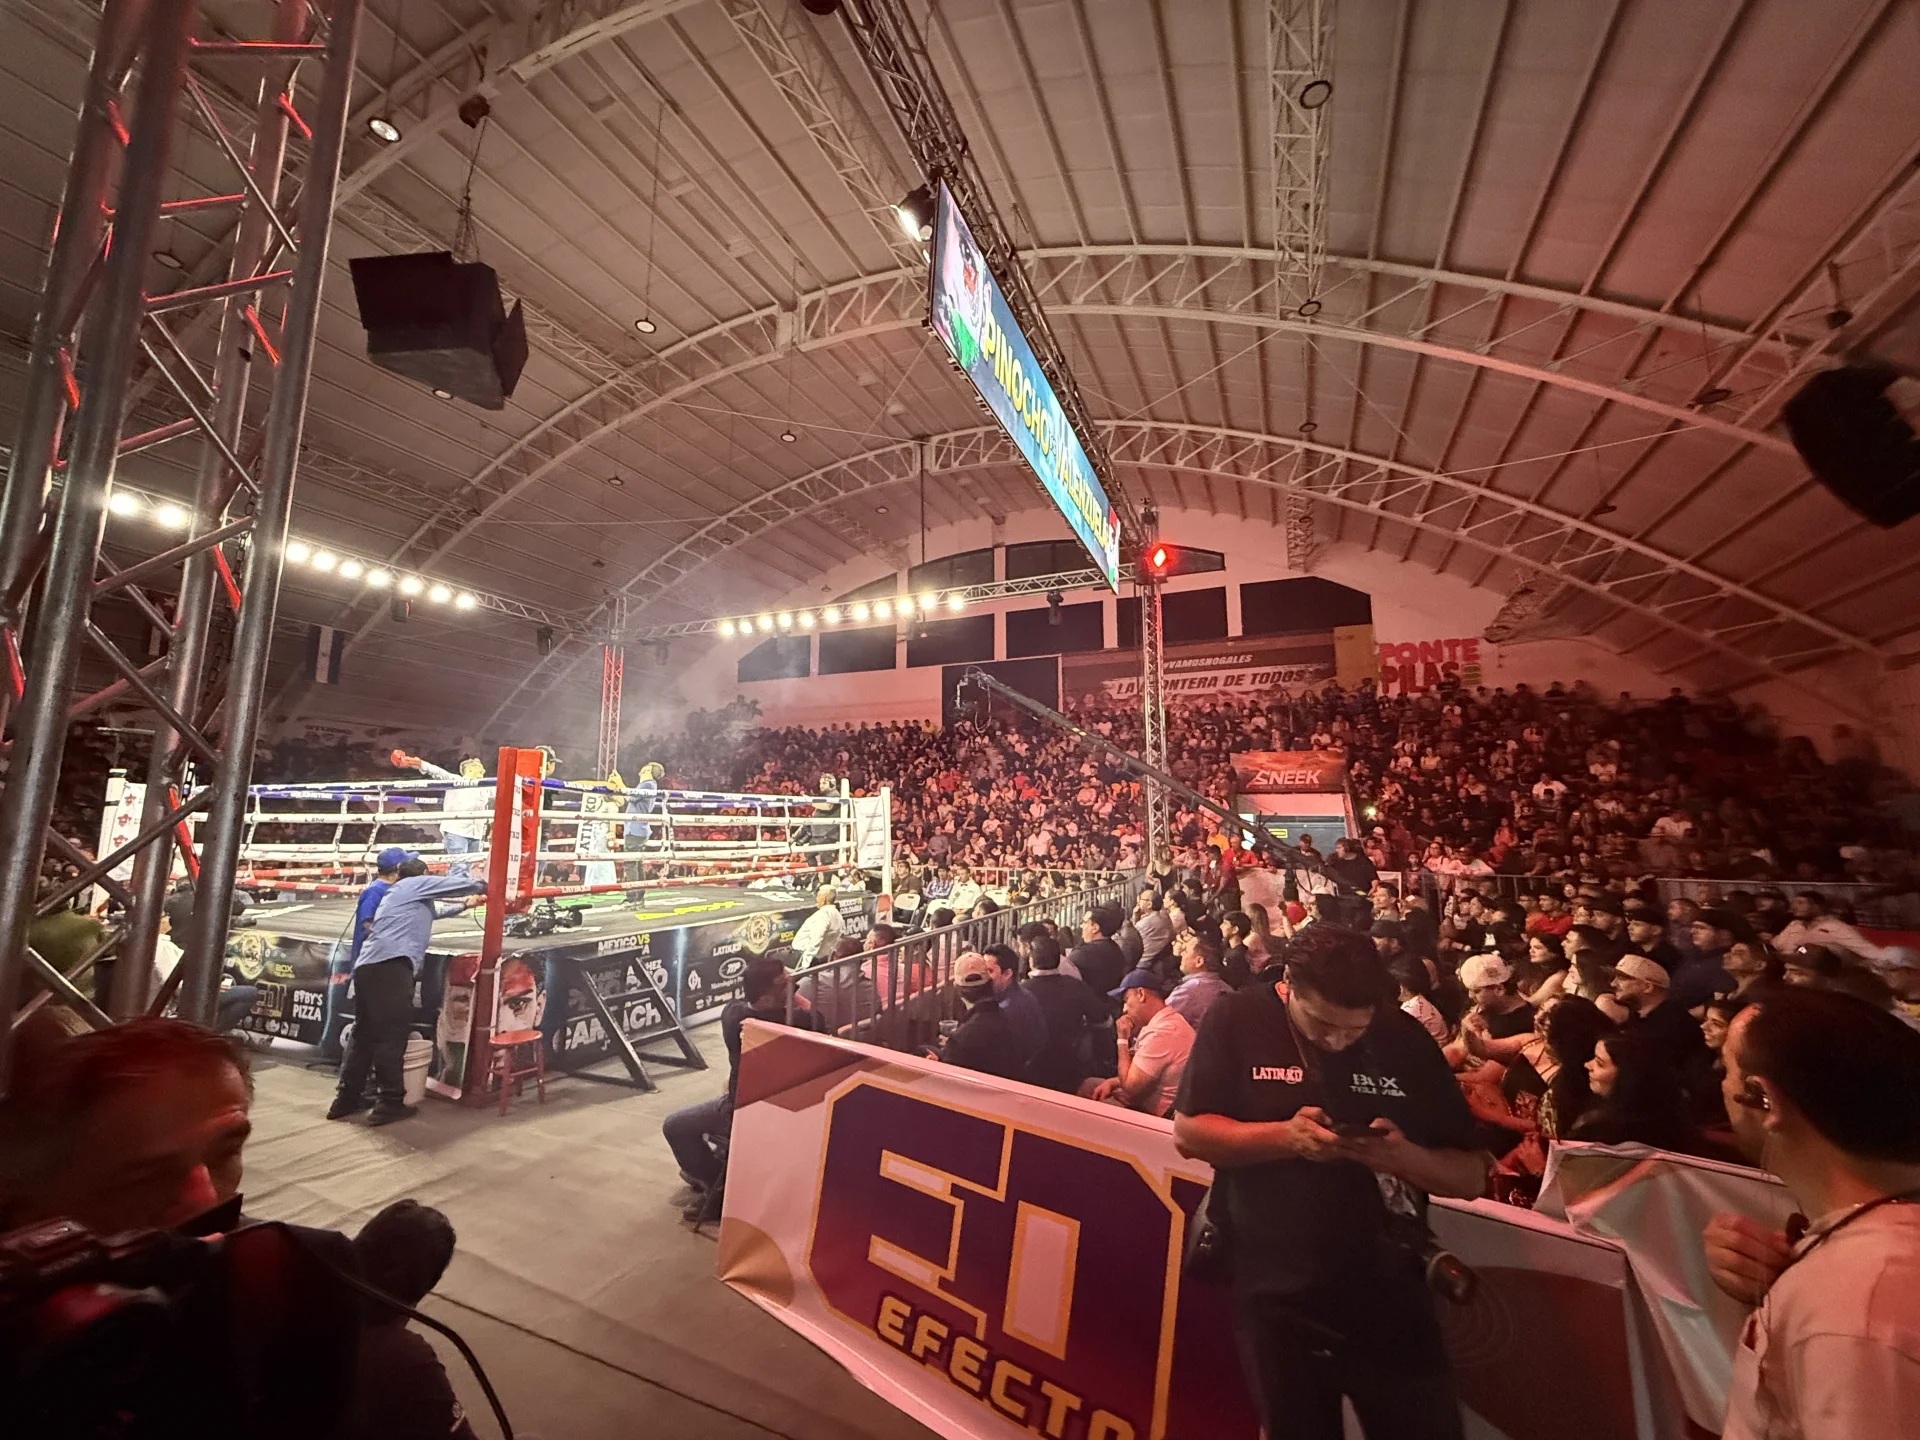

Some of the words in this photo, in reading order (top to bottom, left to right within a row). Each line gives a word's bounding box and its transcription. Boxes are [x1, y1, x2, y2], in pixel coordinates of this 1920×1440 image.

[983, 309, 1051, 456] PINOCHO
[1379, 638, 1480, 665] PONTE
[1116, 682, 1135, 695] LA
[1139, 676, 1217, 692] ONTERA
[1223, 673, 1246, 687] DE
[1251, 670, 1305, 684] TODOS
[637, 933, 650, 945] VS
[275, 963, 293, 973] BOX
[292, 1004, 322, 1022] PIZZA
[1252, 1066, 1303, 1084] LATINKO
[876, 1295, 1136, 1440] EFECTO
